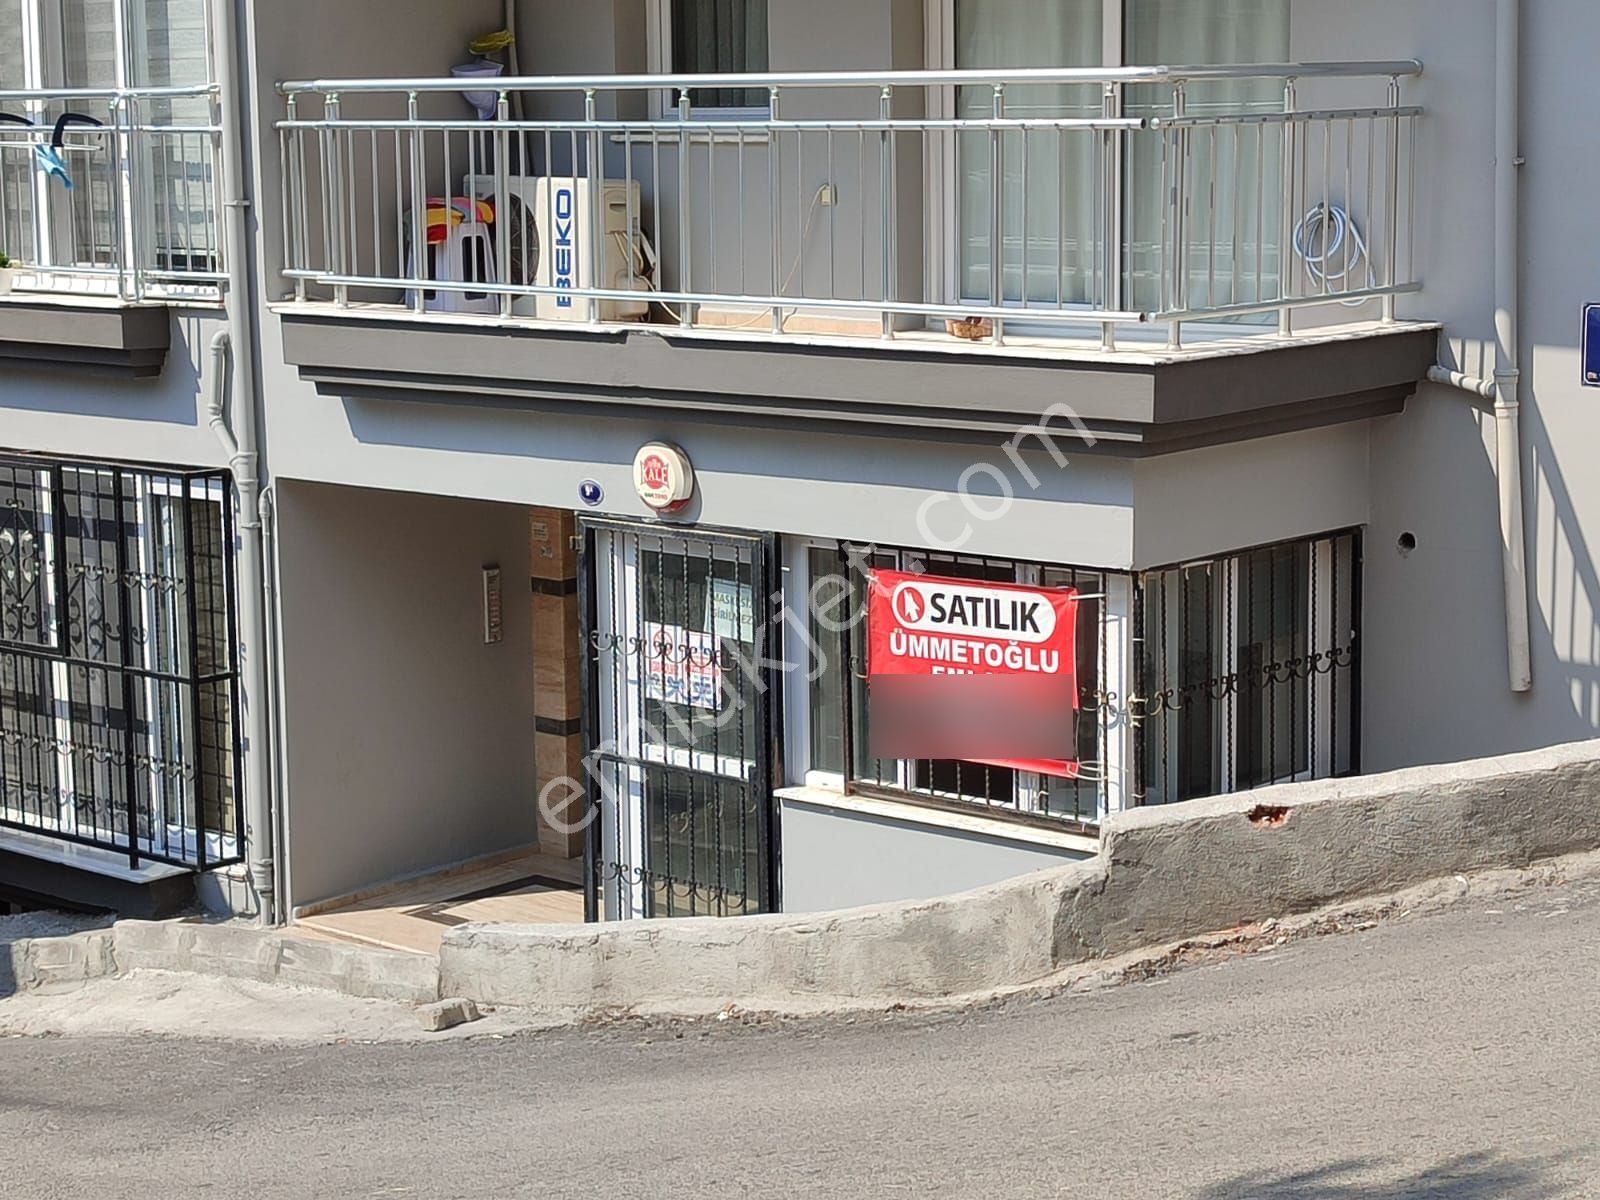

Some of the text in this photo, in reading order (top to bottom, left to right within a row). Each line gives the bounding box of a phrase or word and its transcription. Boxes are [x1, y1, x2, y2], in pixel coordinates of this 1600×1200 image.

[556, 189, 571, 307] BEKO
[641, 464, 669, 485] KALE
[930, 593, 1041, 633] SATILIK
[889, 628, 1059, 673] ÜMMETOĞLU
